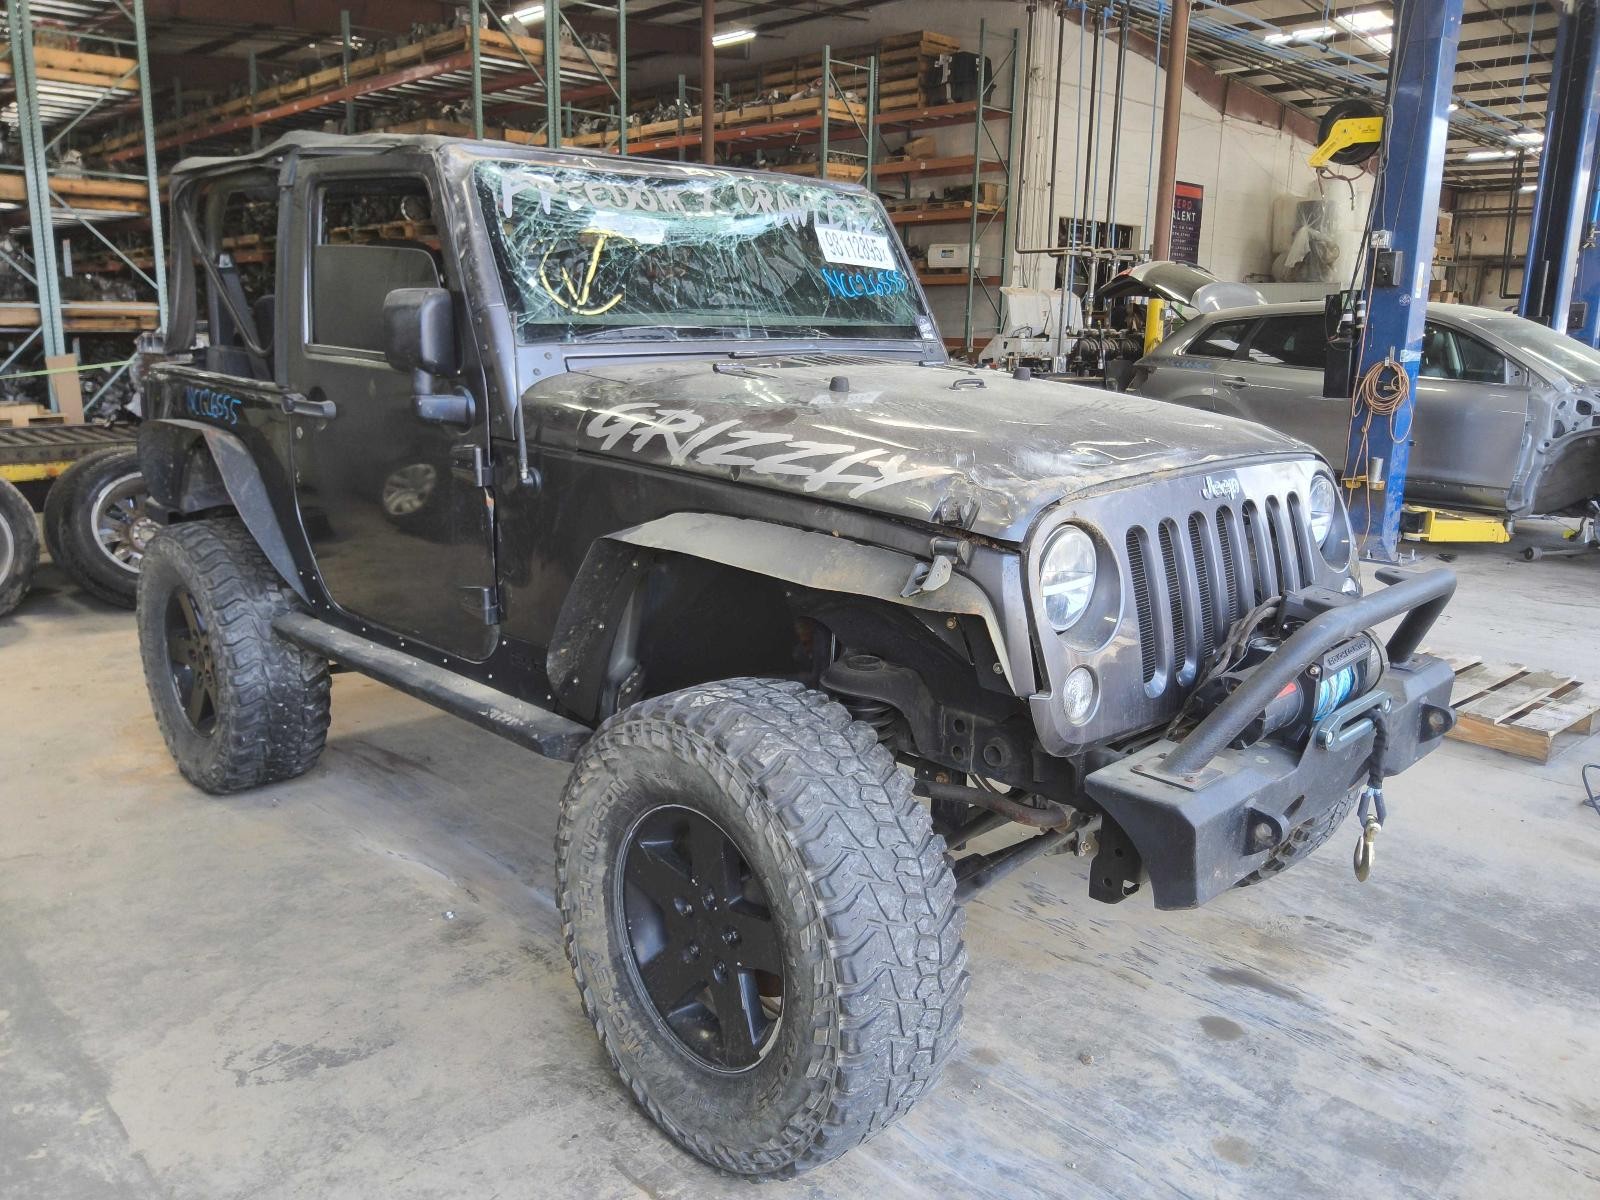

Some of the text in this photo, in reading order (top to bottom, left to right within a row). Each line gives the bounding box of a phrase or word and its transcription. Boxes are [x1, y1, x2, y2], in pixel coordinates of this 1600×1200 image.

[1173, 210, 1196, 222] ALENT
[585, 402, 930, 499] GRIZZLY
[1200, 475, 1240, 500] Jeep
